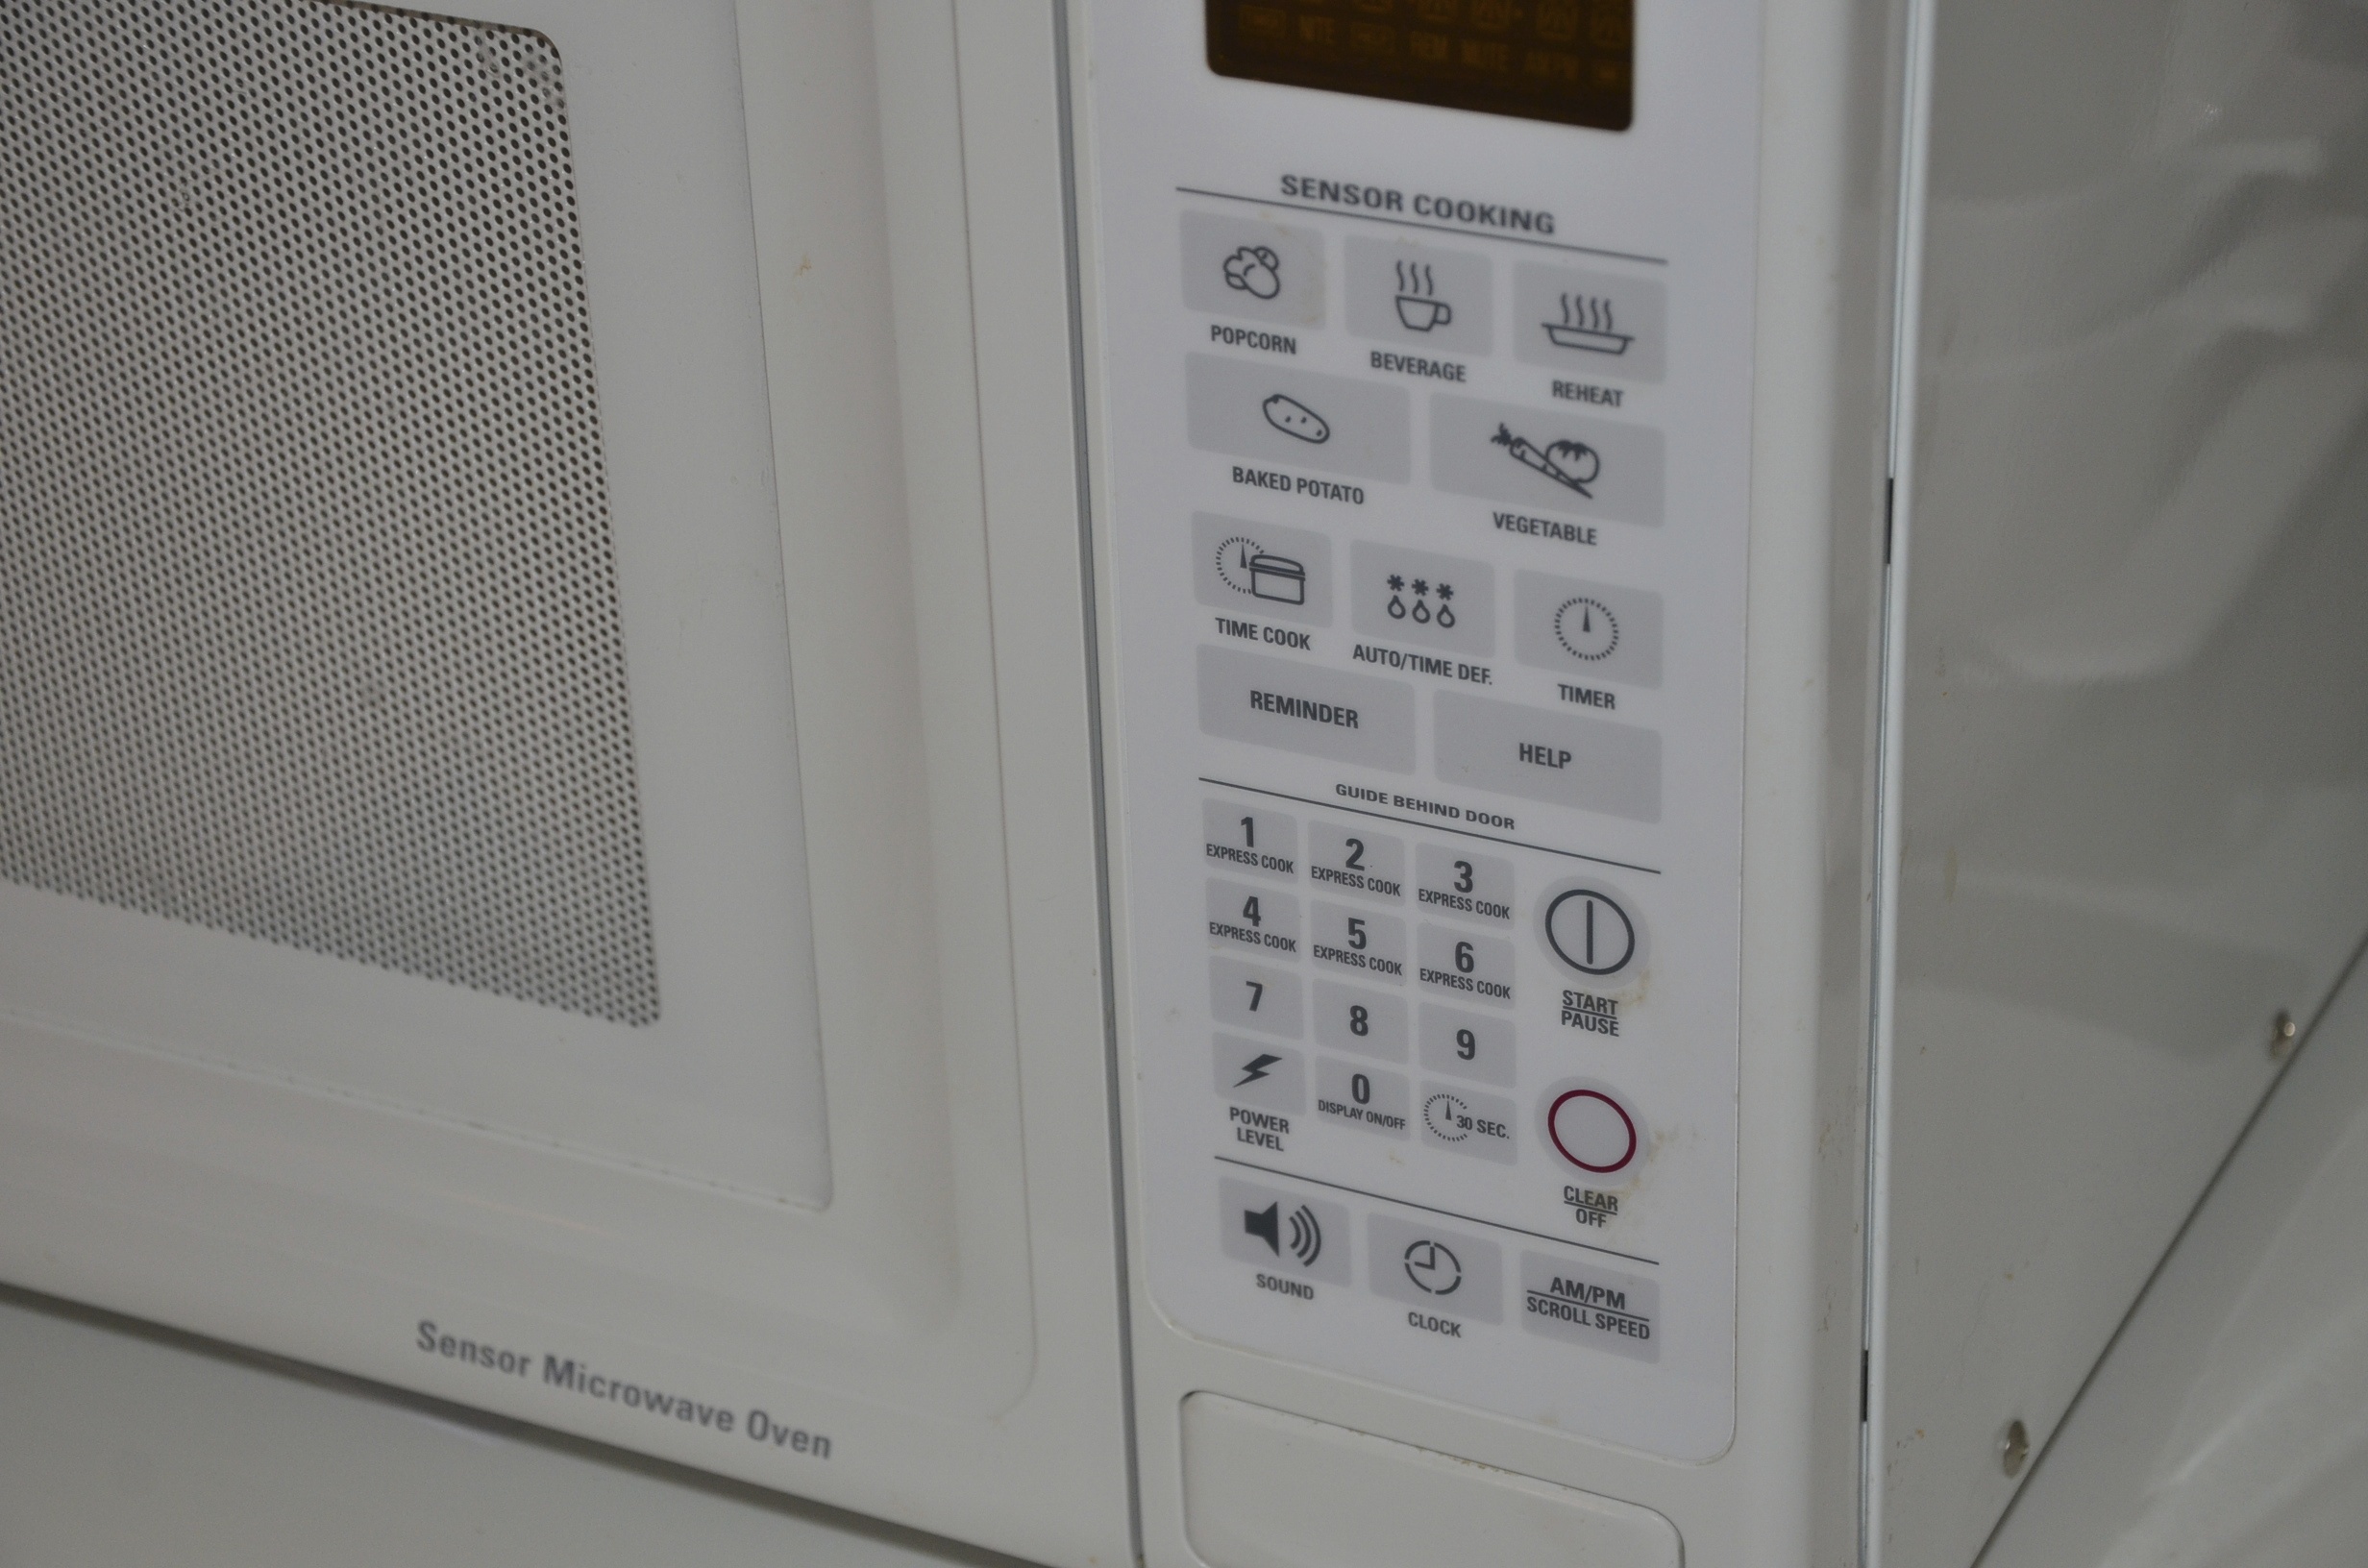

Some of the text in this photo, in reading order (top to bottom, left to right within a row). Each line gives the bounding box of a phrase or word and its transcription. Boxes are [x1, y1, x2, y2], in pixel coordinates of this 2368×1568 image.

[1281, 175, 1554, 233] SENSOR COOKING
[1211, 325, 1296, 355] POPCORN
[1370, 352, 1467, 382] BEVERAGE
[1552, 380, 1623, 407] REHEAT
[1232, 466, 1365, 504] BAKED POTATO
[1492, 512, 1597, 545] VEGETABLE
[1215, 618, 1311, 649] TIME COOK
[1353, 645, 1492, 685] AUTO/TIME DEF.
[1249, 691, 1358, 728] REMINDER
[1557, 684, 1616, 710] TIMER
[1518, 743, 1572, 769] HELP
[1335, 784, 1516, 829] GUIDE BEHIND DOOR
[1241, 817, 1255, 847] 1
[1206, 844, 1294, 874] EXPRESS COOK
[1345, 838, 1366, 870] 2
[1311, 866, 1400, 896] EXPRESS COOK
[1454, 861, 1473, 893] 3
[1243, 896, 1261, 926] 4
[1418, 889, 1510, 919] EXPRESS COOK
[1209, 921, 1296, 953] EXPRESS COOK
[1347, 918, 1367, 949] 5
[1313, 944, 1402, 976] EXPRESS COOK
[1455, 942, 1474, 973] 6
[1246, 982, 1264, 1012] 7
[1419, 968, 1511, 999] EXPRESS COOK
[1562, 991, 1618, 1015] START
[1349, 1005, 1369, 1037] 8
[1562, 1011, 1619, 1037] PAUSE
[1456, 1029, 1476, 1060] 9
[1351, 1074, 1370, 1104] 0
[1229, 1107, 1290, 1134] POWER
[1318, 1100, 1405, 1131] DISPLAY ON/OFF
[1456, 1115, 1510, 1139] 30 SEC.
[1237, 1127, 1284, 1152] LEVEL
[1564, 1186, 1618, 1212] CLEAR
[1575, 1208, 1607, 1229] OFF
[1256, 1274, 1314, 1301] SOUND
[1550, 1277, 1626, 1311] AM/PM
[1408, 1312, 1462, 1338] CLOCK
[1527, 1297, 1650, 1340] SCROLL SPEED
[417, 1320, 831, 1459] Sensor Microwave Oven
